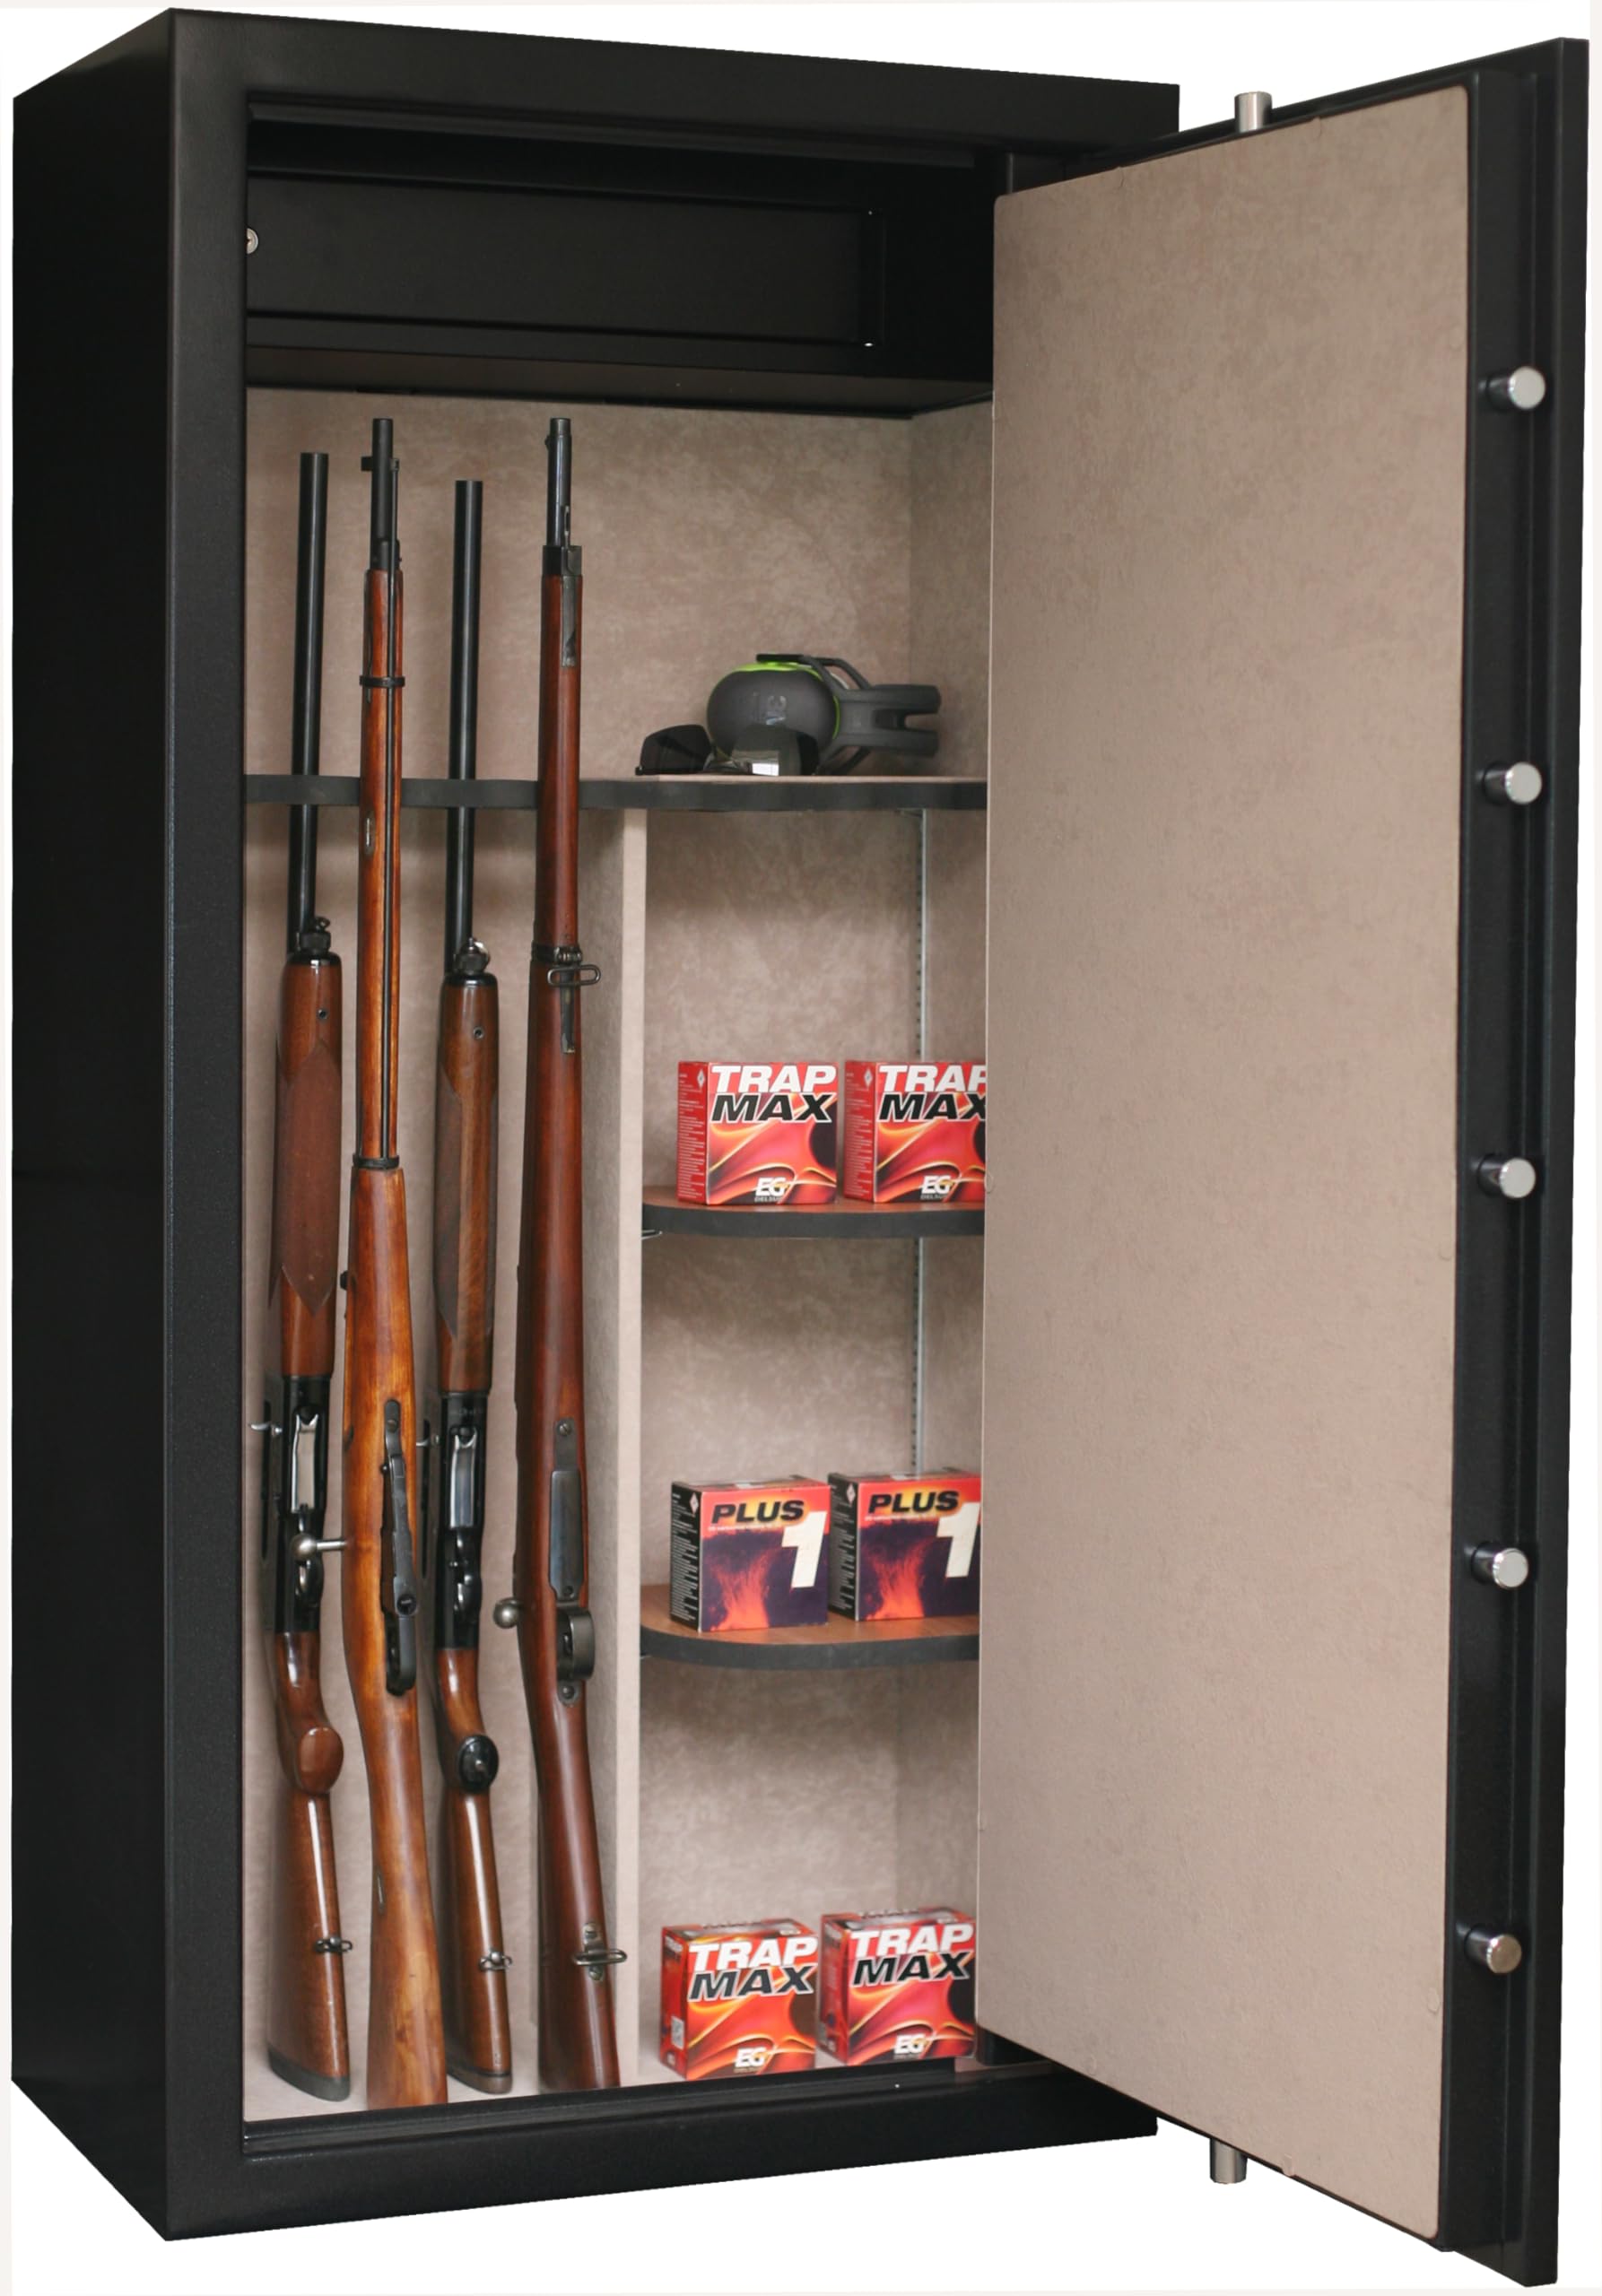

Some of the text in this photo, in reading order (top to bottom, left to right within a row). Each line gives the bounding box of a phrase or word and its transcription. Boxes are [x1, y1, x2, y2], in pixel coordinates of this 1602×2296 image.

[711, 1065, 837, 1092] TRAP
[710, 1091, 837, 1123] MAX
[878, 1091, 986, 1122] MAX
[755, 1177, 787, 1196] EG
[921, 1175, 952, 1195] EG
[710, 1499, 805, 1525] PLUS
[781, 1510, 827, 1588] 1
[868, 1490, 980, 1578] PLUS 1
[689, 1936, 818, 1972] TRAP
[850, 1924, 974, 1959] TRAP
[687, 1962, 817, 2002] MAX
[853, 1949, 975, 1987] MAX
[735, 2048, 767, 2067] EG
[894, 2034, 926, 2054] EG
